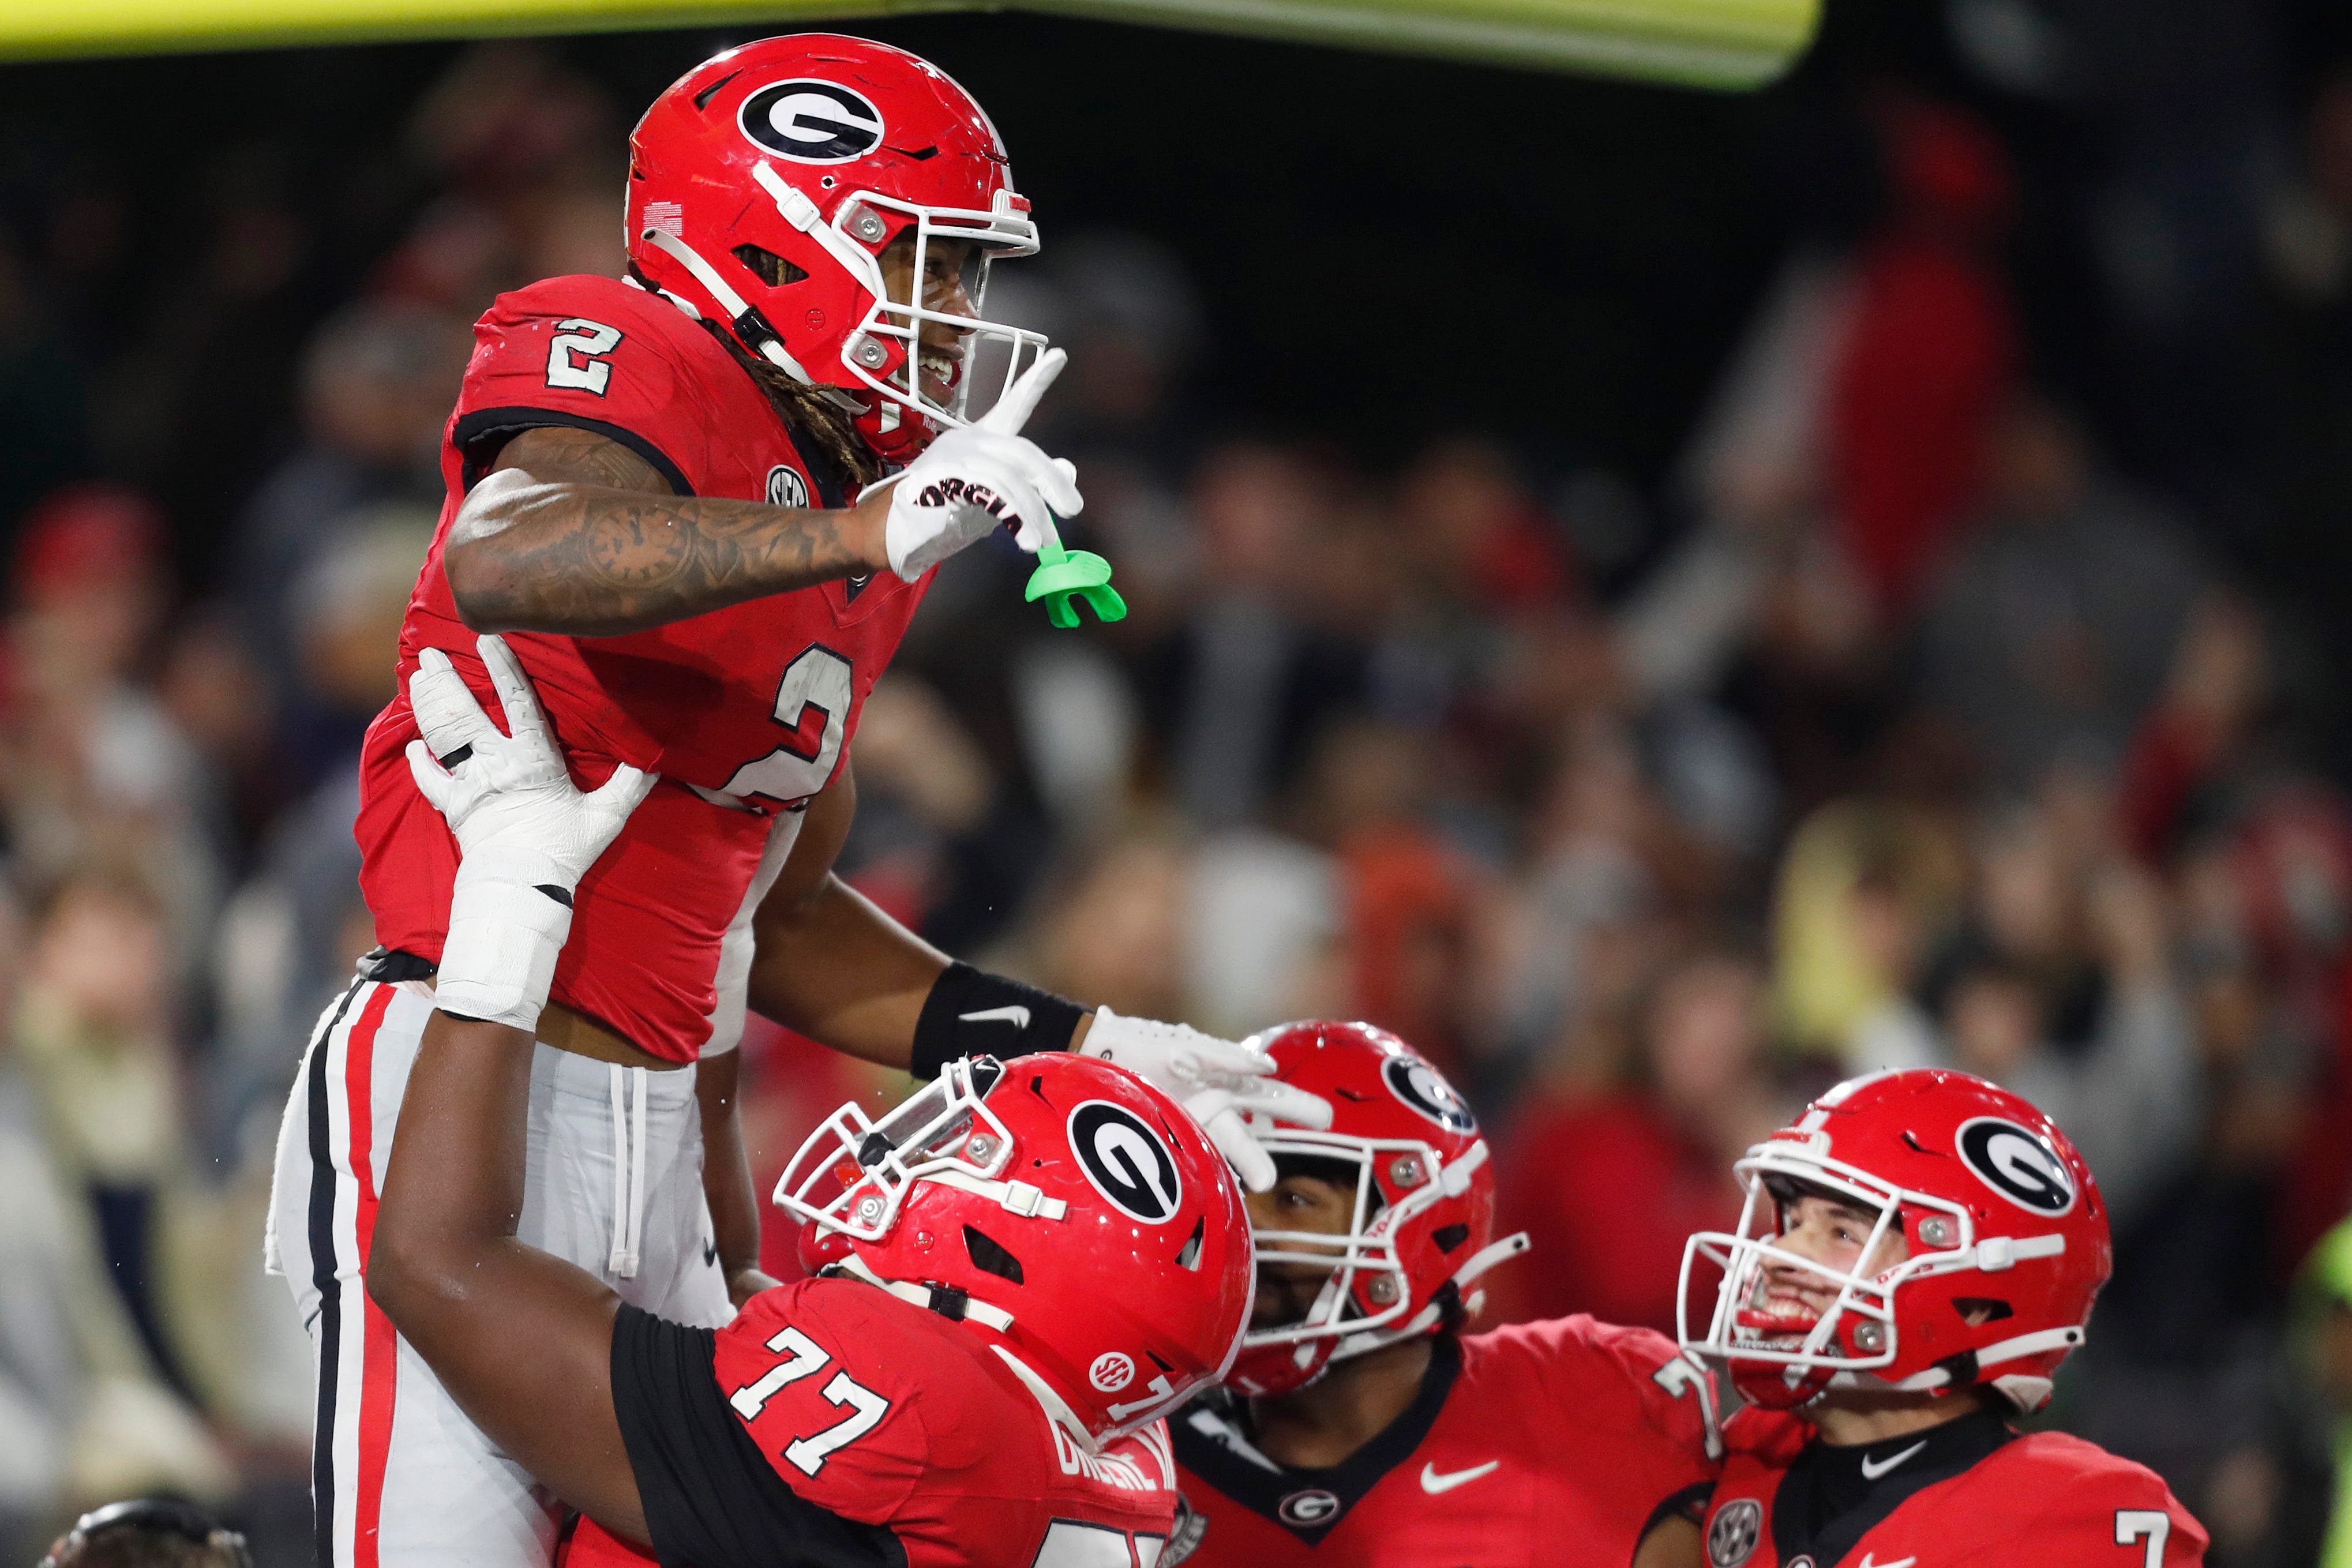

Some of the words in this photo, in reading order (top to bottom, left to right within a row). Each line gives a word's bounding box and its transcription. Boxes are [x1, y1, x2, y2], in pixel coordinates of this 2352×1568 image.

[742, 82, 879, 159] G
[545, 316, 625, 398] 2
[685, 642, 853, 815] 2
[1072, 1104, 1177, 1218] G
[1963, 1121, 2070, 1210] G
[729, 1325, 892, 1480] 77
[1096, 1357, 1130, 1387] SEC
[2114, 1509, 2171, 1568] 7
